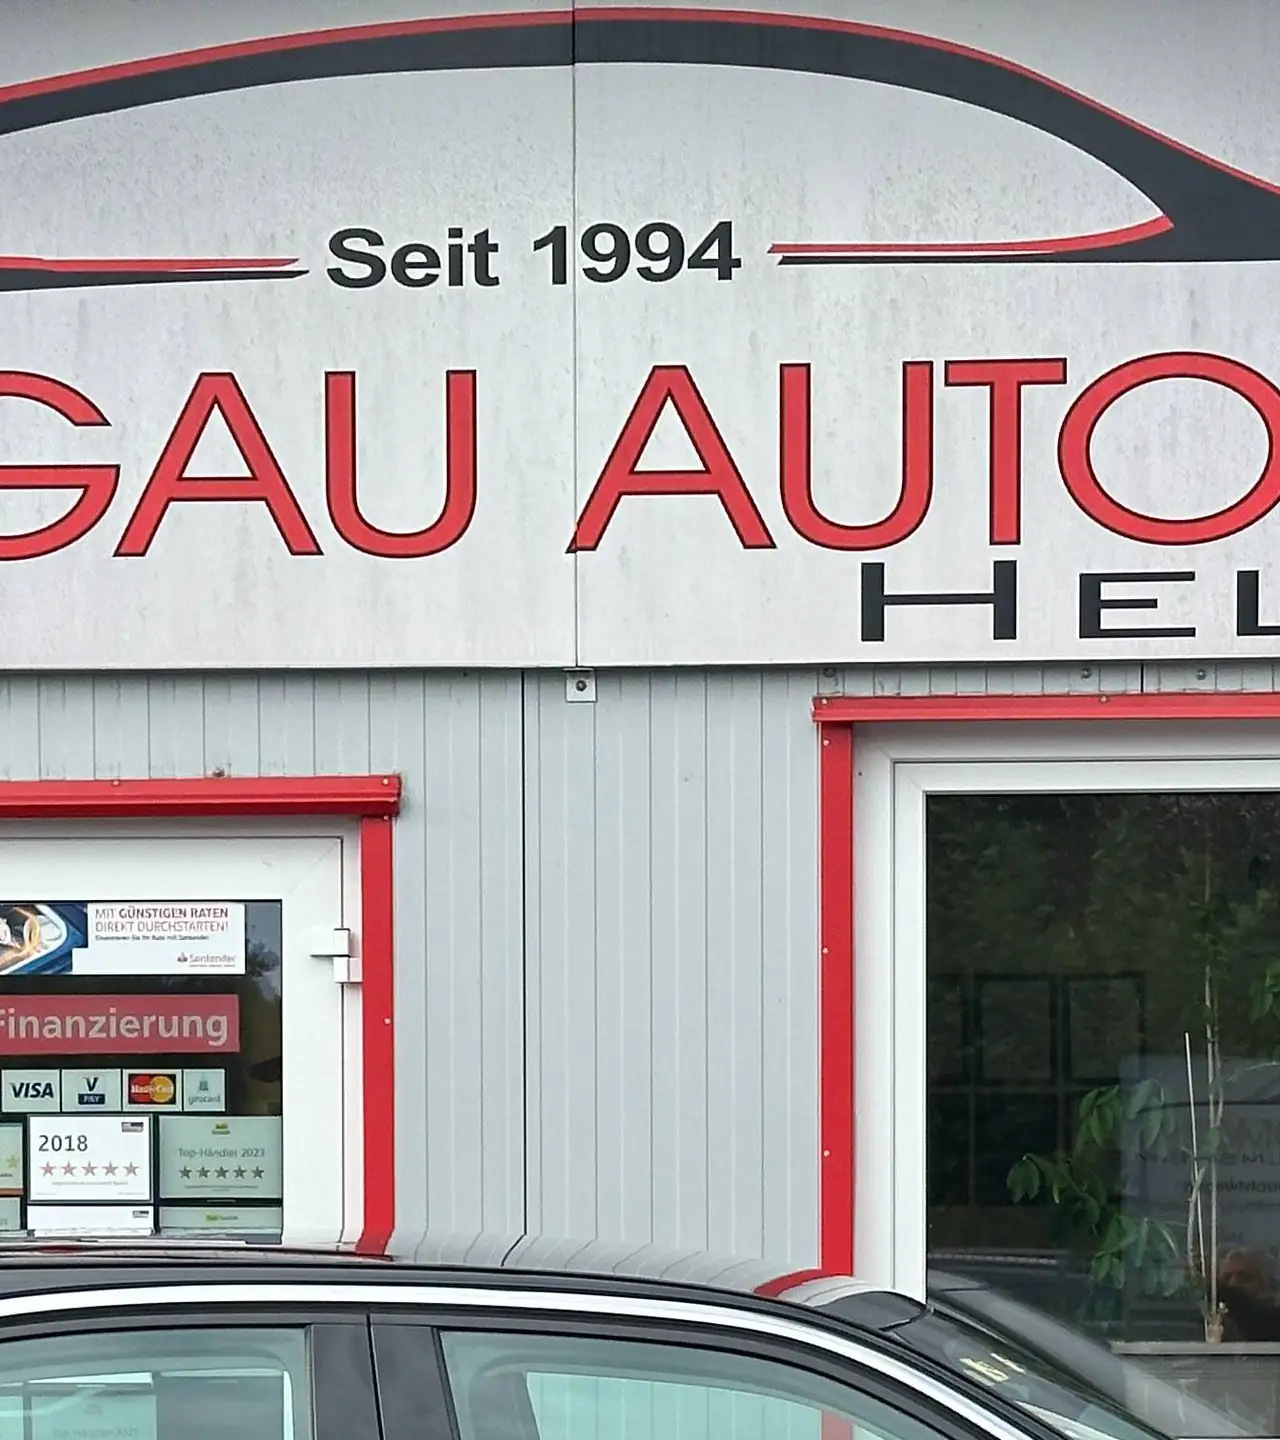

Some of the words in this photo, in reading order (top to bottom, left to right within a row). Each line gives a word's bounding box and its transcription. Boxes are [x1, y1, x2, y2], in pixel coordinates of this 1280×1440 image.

[326, 226, 500, 288] Seit
[531, 220, 742, 285] 1994
[95, 908, 114, 919] MIT
[191, 907, 229, 918] RATEN
[95, 921, 134, 932] DIREKT
[9, 1082, 54, 1098] VISA
[83, 1076, 99, 1092] V
[38, 1134, 88, 1152] 2018
[178, 1147, 238, 1159] Top-Händler
